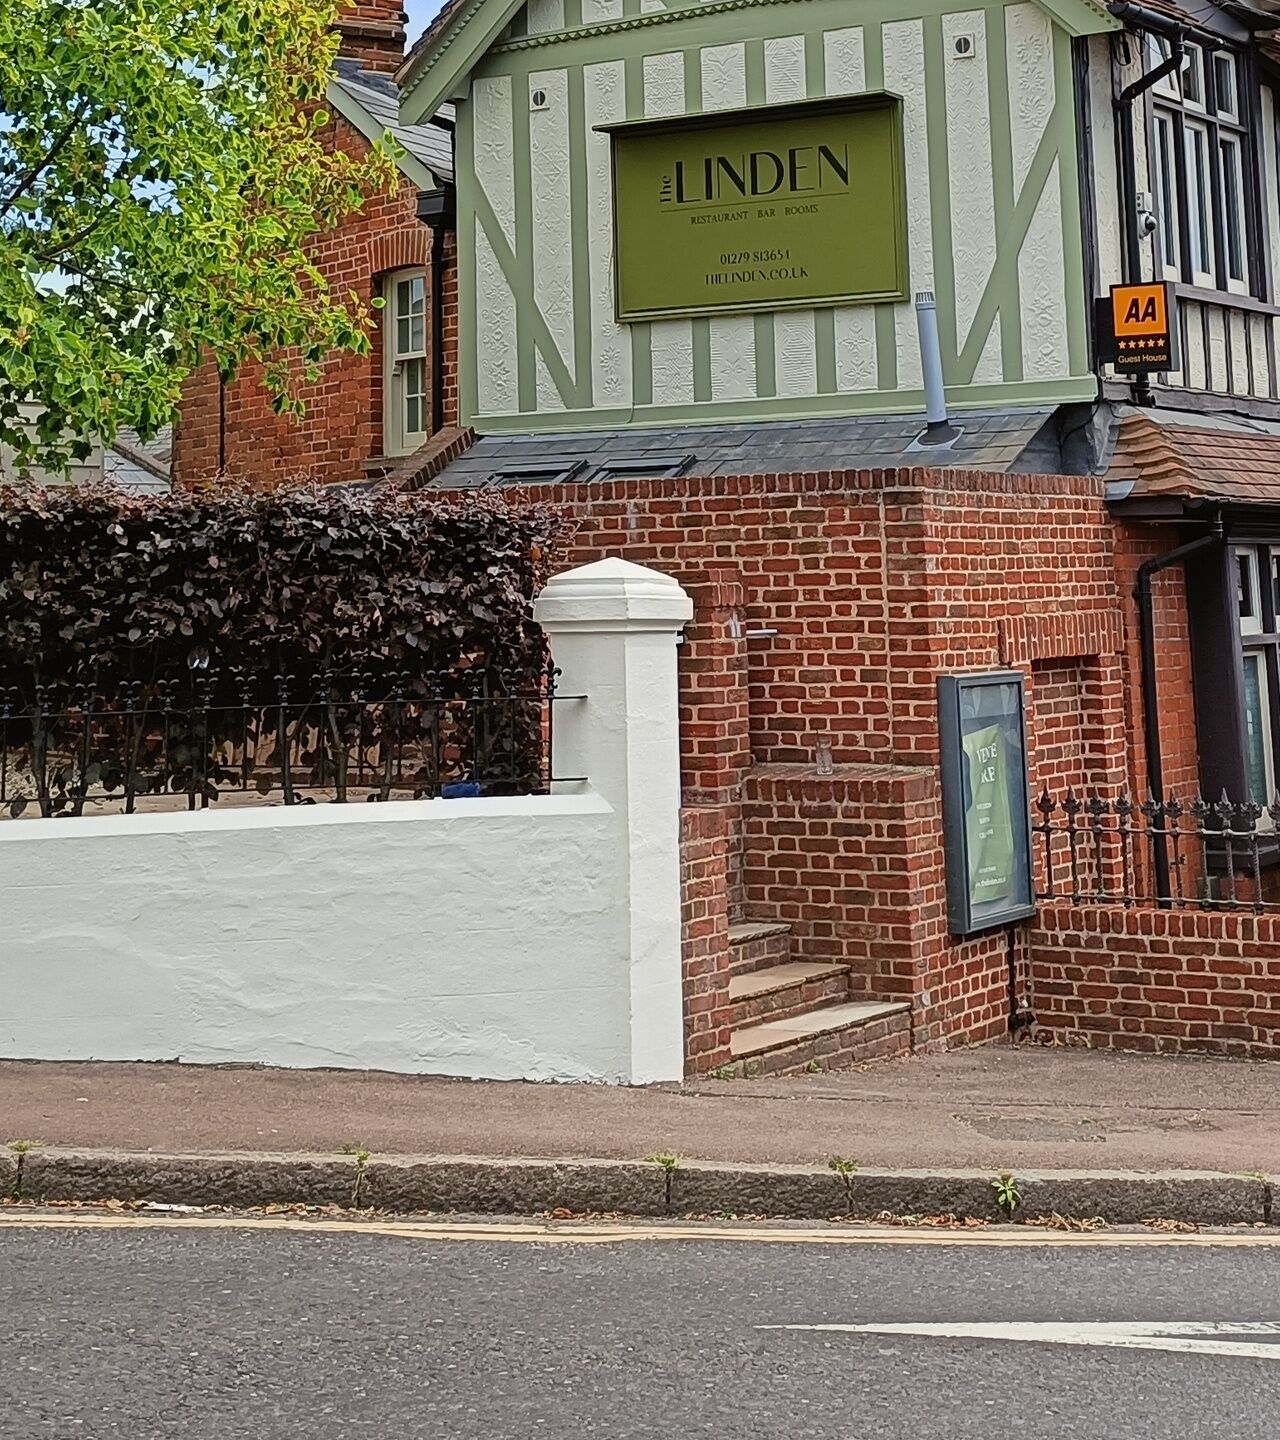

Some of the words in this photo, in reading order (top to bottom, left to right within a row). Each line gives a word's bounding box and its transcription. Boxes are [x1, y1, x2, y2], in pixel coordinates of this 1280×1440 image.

[675, 144, 850, 204] LINDEN
[690, 211, 749, 225] RESTAURANT
[757, 209, 776, 219] BAR
[784, 204, 819, 216] ROOMS
[1124, 297, 1157, 324] AA
[1118, 355, 1141, 363] Guest
[1142, 354, 1167, 362] House
